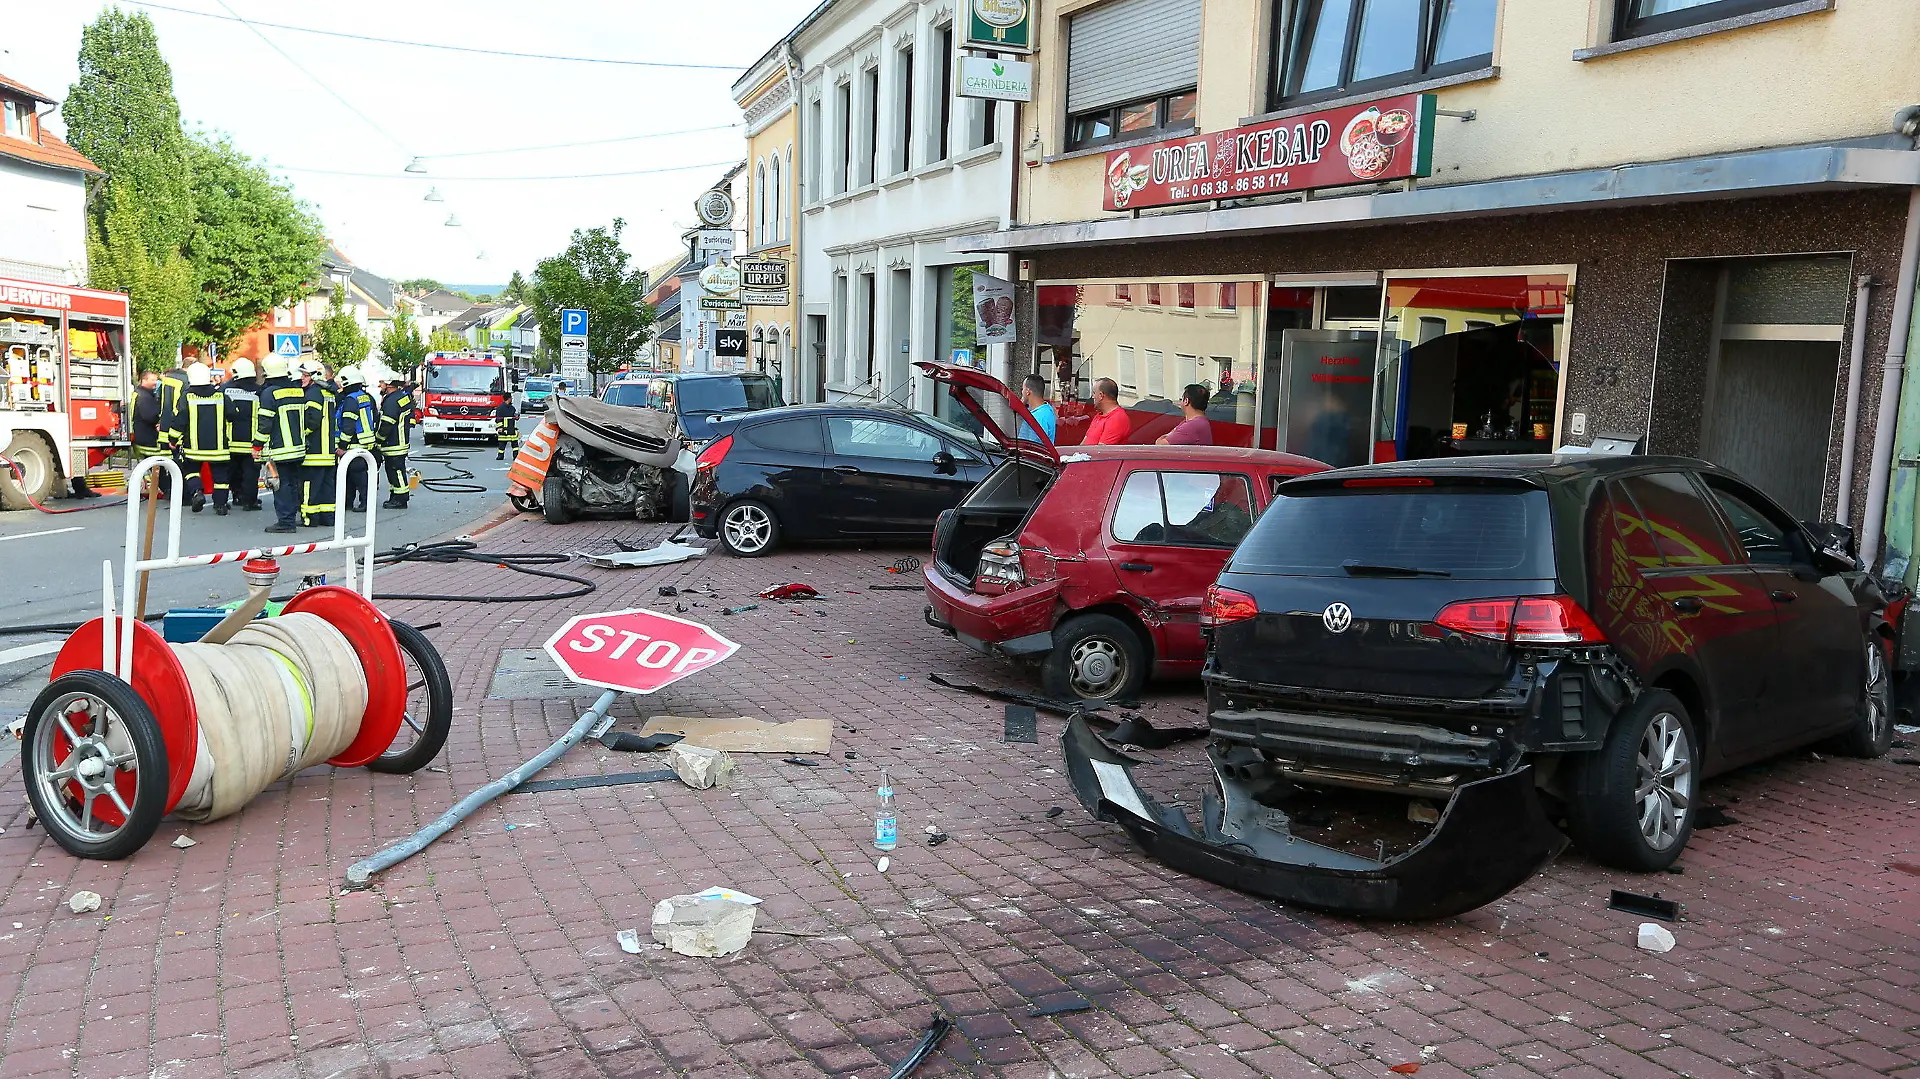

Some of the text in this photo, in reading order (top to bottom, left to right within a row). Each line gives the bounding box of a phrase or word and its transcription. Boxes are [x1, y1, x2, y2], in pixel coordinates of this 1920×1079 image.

[966, 77, 1028, 92] CARINDERIA
[1152, 119, 1330, 185] URFA KEBAP
[1170, 186, 1190, 199] Tel.:
[1192, 184, 1198, 197] 0
[1200, 183, 1213, 196] 68
[1215, 181, 1228, 194] 38
[1235, 179, 1249, 192] 86
[1251, 177, 1265, 190] 58
[1269, 173, 1289, 188] 174
[744, 263, 785, 272] KARLSBERG
[747, 273, 783, 284] UR-PILS
[567, 312, 582, 332] P
[719, 335, 743, 351] sky
[440, 395, 489, 403] FEUERWEHR
[568, 623, 717, 674] STOP
